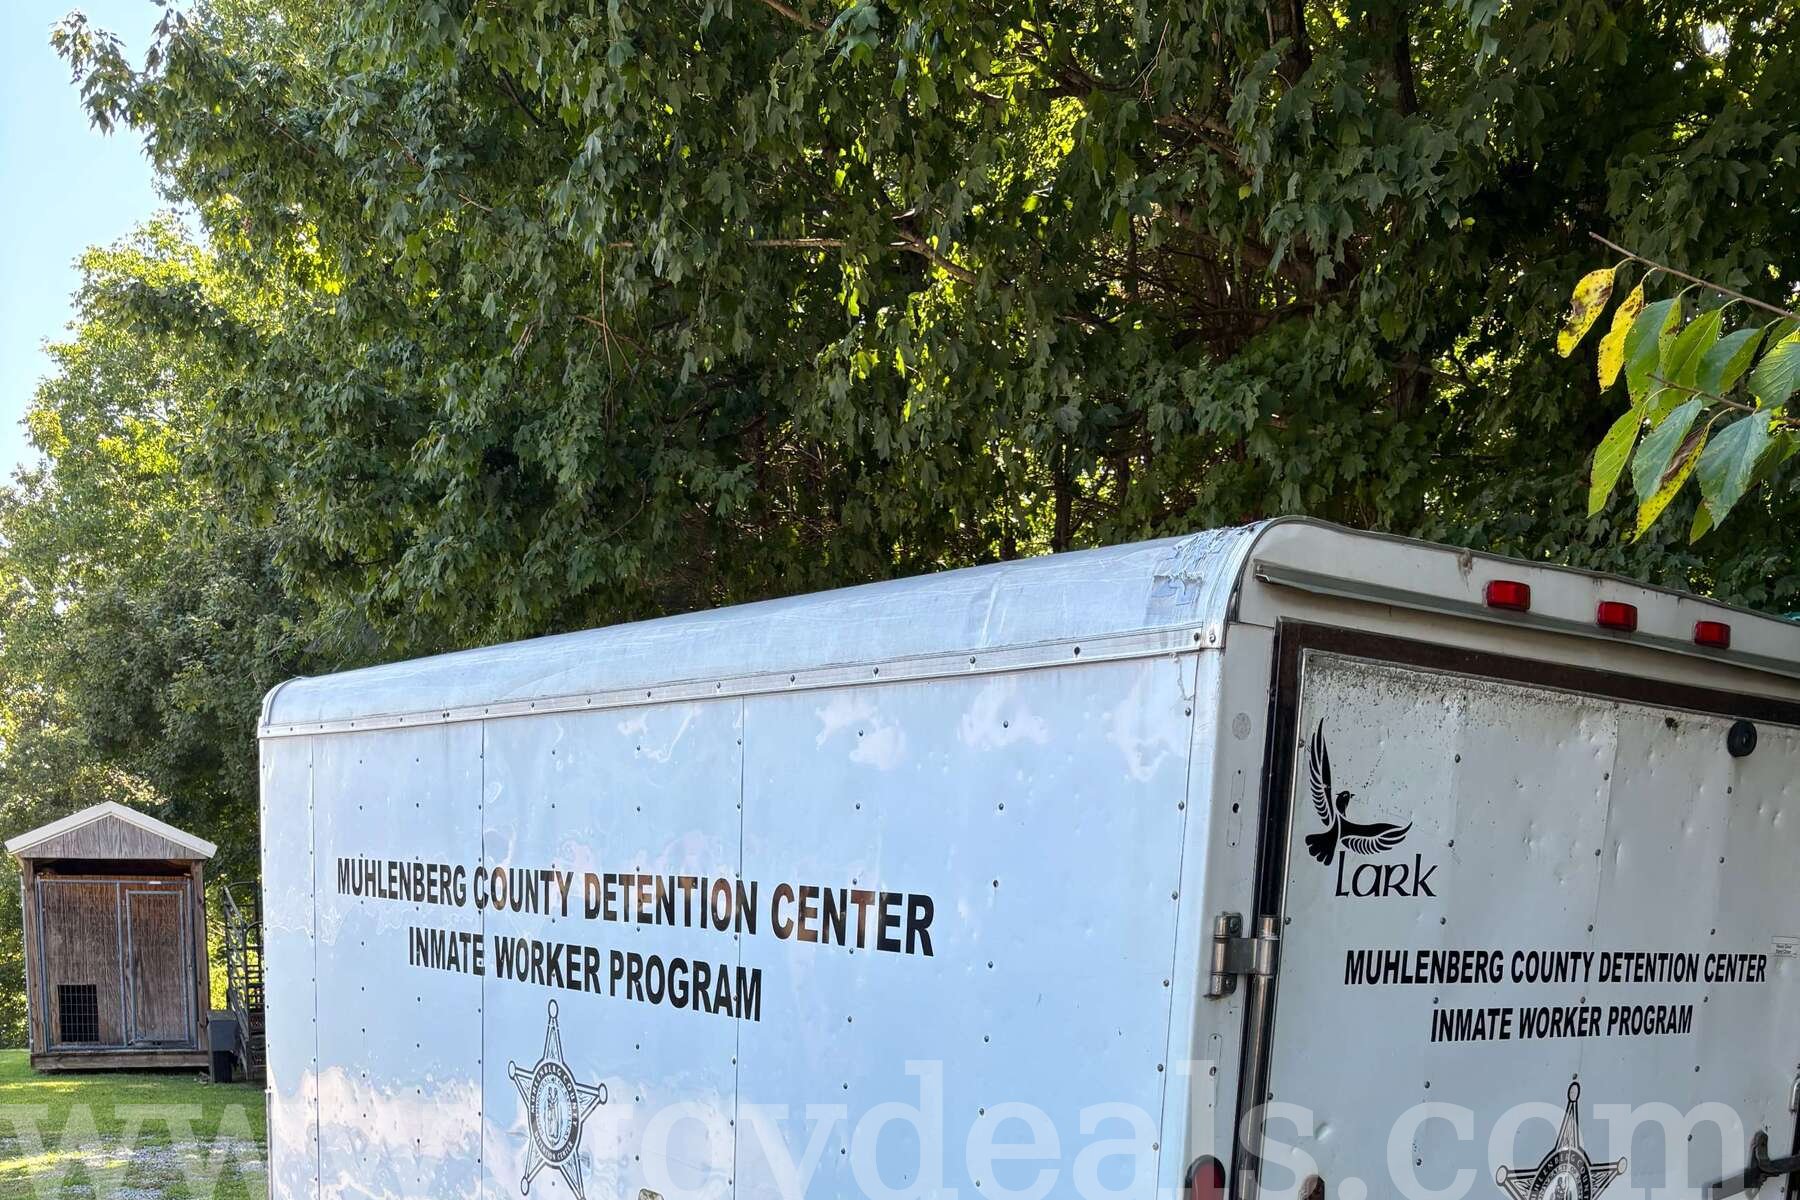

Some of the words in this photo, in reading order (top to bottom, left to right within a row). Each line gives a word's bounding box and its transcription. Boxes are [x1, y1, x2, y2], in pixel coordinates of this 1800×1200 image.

[337, 857, 467, 907] MUHLENBERG
[474, 865, 574, 918] COUNTY
[585, 872, 758, 935] DETENTION
[771, 883, 935, 957] CENTER
[409, 926, 485, 976] INMATE
[494, 935, 600, 994] WORKER
[610, 951, 762, 1022] PROGRAM
[1344, 949, 1504, 985] MUHLENBERG
[1510, 950, 1596, 984] COUNTY
[1599, 951, 1699, 983] DETENTION
[1704, 953, 1767, 984] CENTER
[1430, 1007, 1513, 1043] INMATE
[1518, 1005, 1601, 1039] WORKER
[1607, 1004, 1693, 1037] PROGRAM
